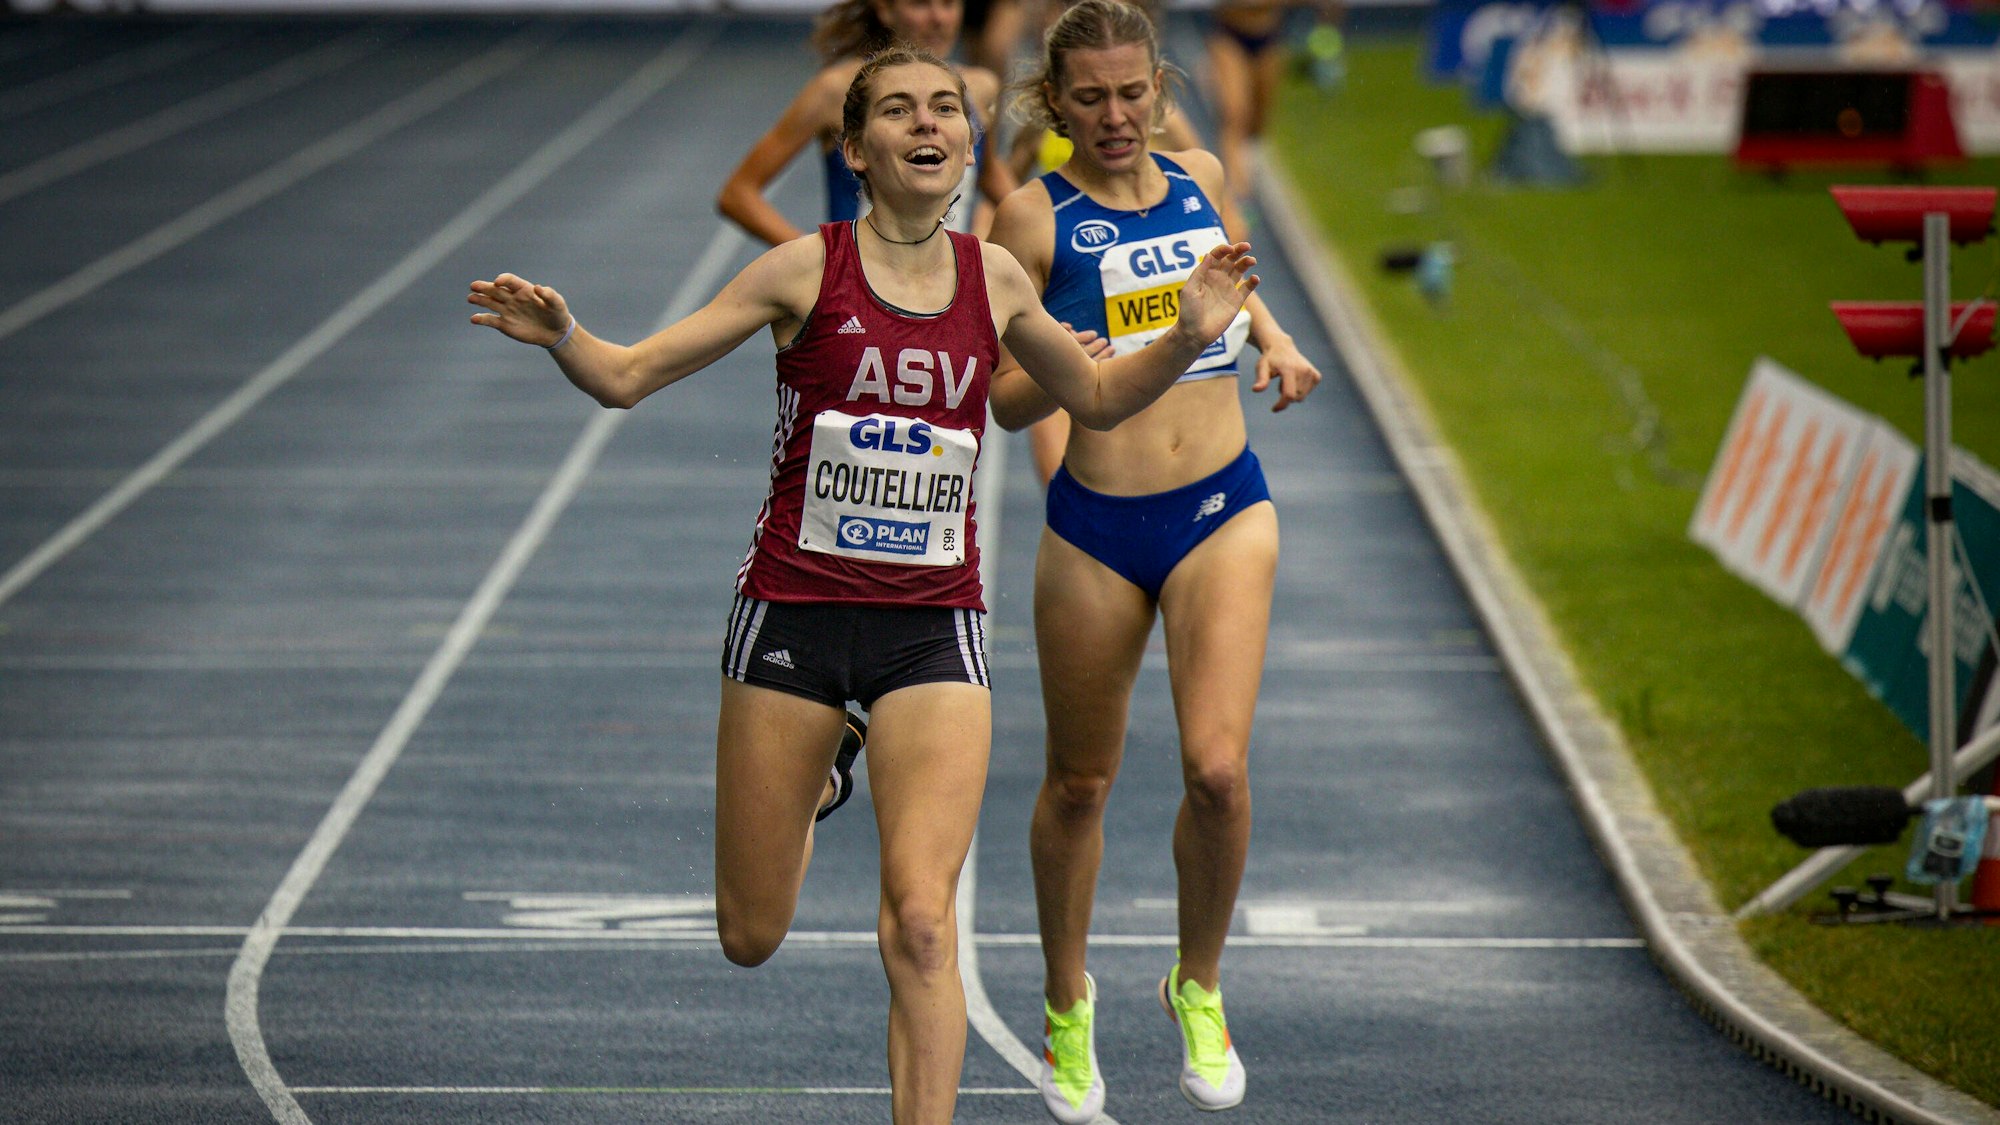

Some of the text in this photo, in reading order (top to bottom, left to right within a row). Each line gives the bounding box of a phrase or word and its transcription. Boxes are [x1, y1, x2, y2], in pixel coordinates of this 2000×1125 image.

[837, 326, 866, 334] adidas
[846, 347, 977, 410] ASV
[815, 460, 964, 513] COUTELLIER
[877, 525, 926, 543] PLAN
[943, 528, 955, 551] 663
[876, 541, 923, 551] INTERNATIONAL
[762, 653, 795, 670] adidas
